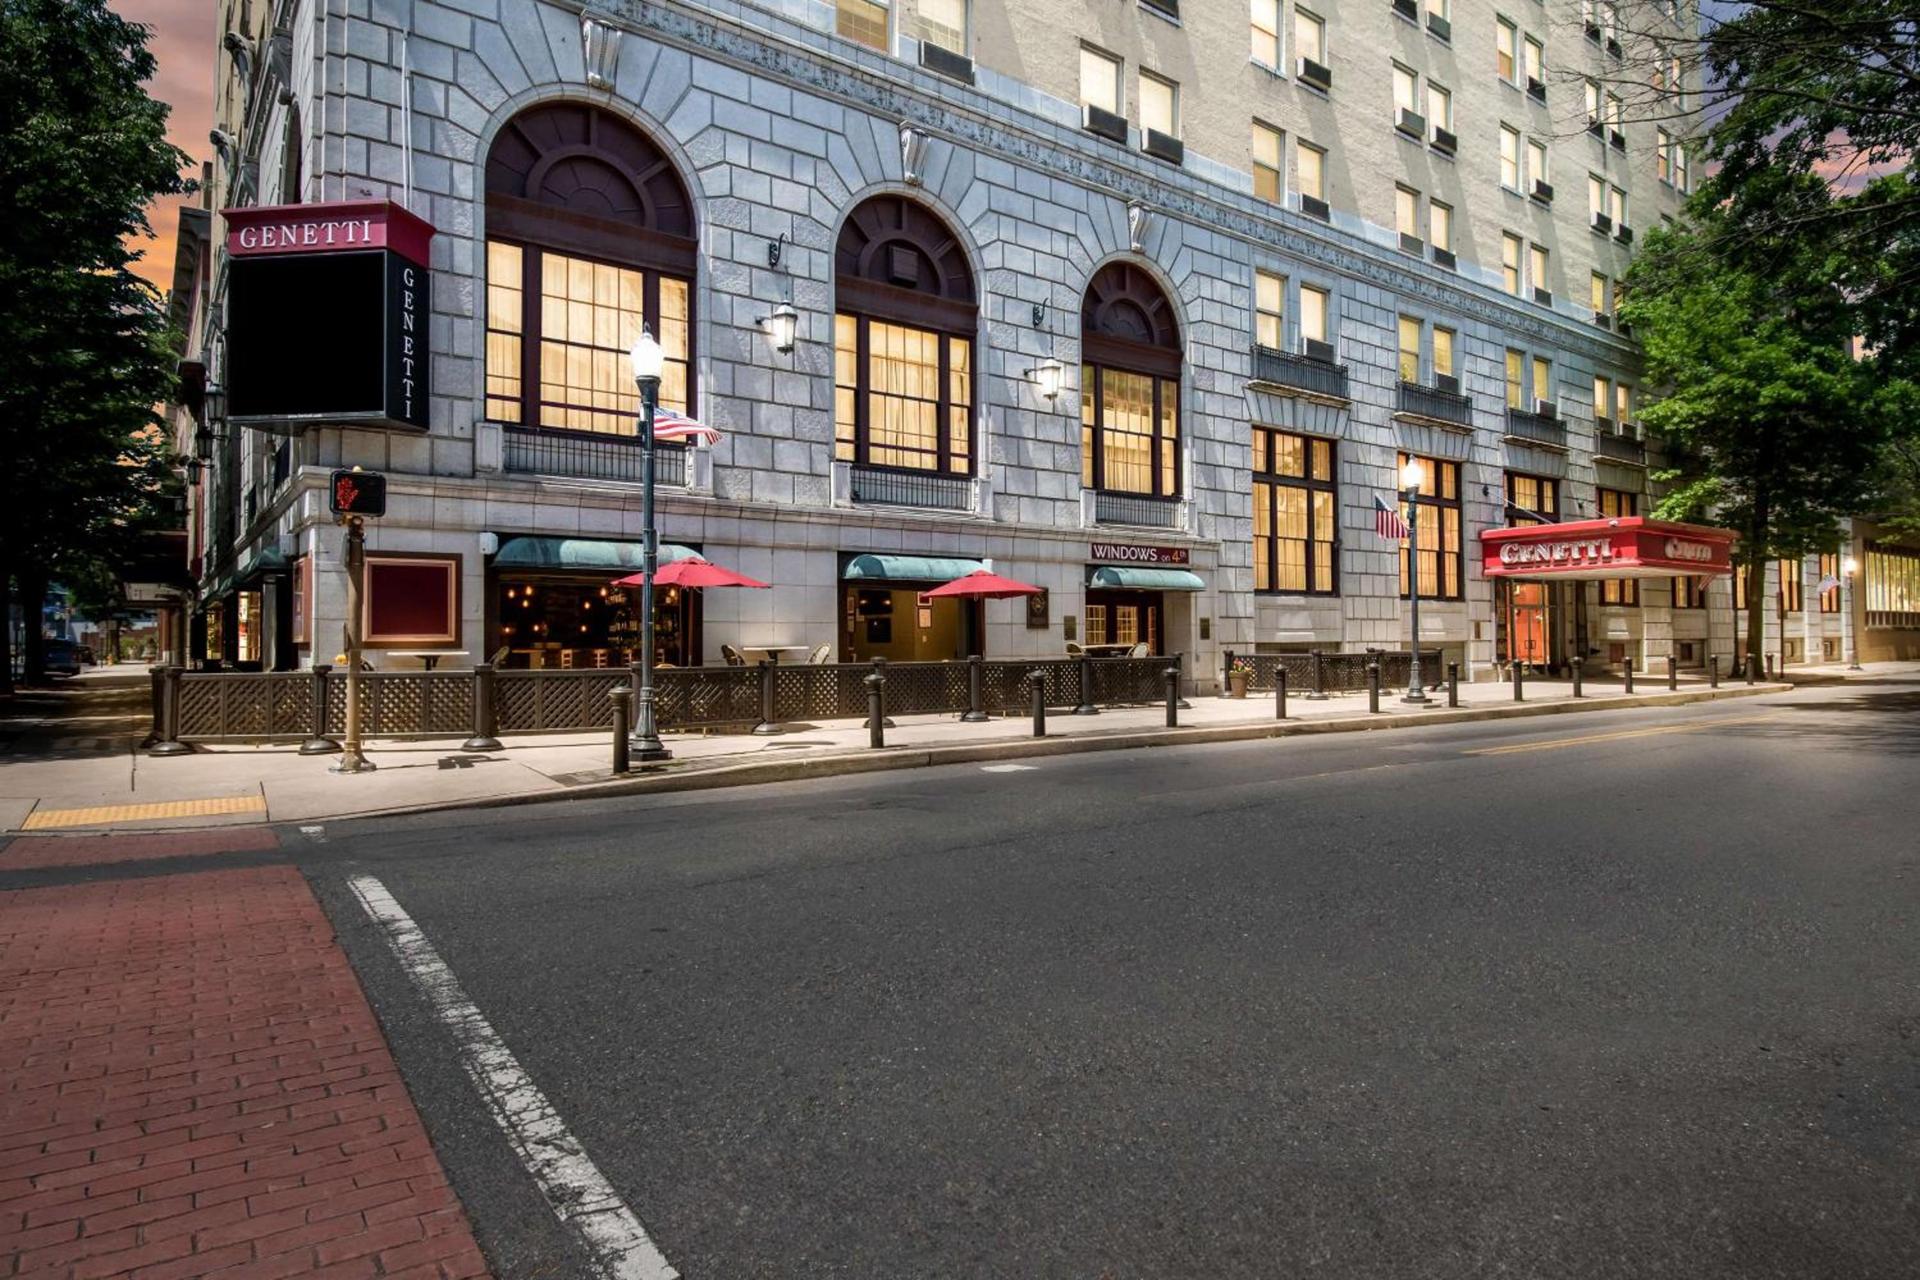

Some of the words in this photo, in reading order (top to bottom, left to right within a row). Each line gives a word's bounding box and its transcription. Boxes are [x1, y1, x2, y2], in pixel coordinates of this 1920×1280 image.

[239, 219, 371, 248] GENETTI
[403, 268, 415, 418] GENETTI
[1093, 543, 1158, 562] WINDOWS
